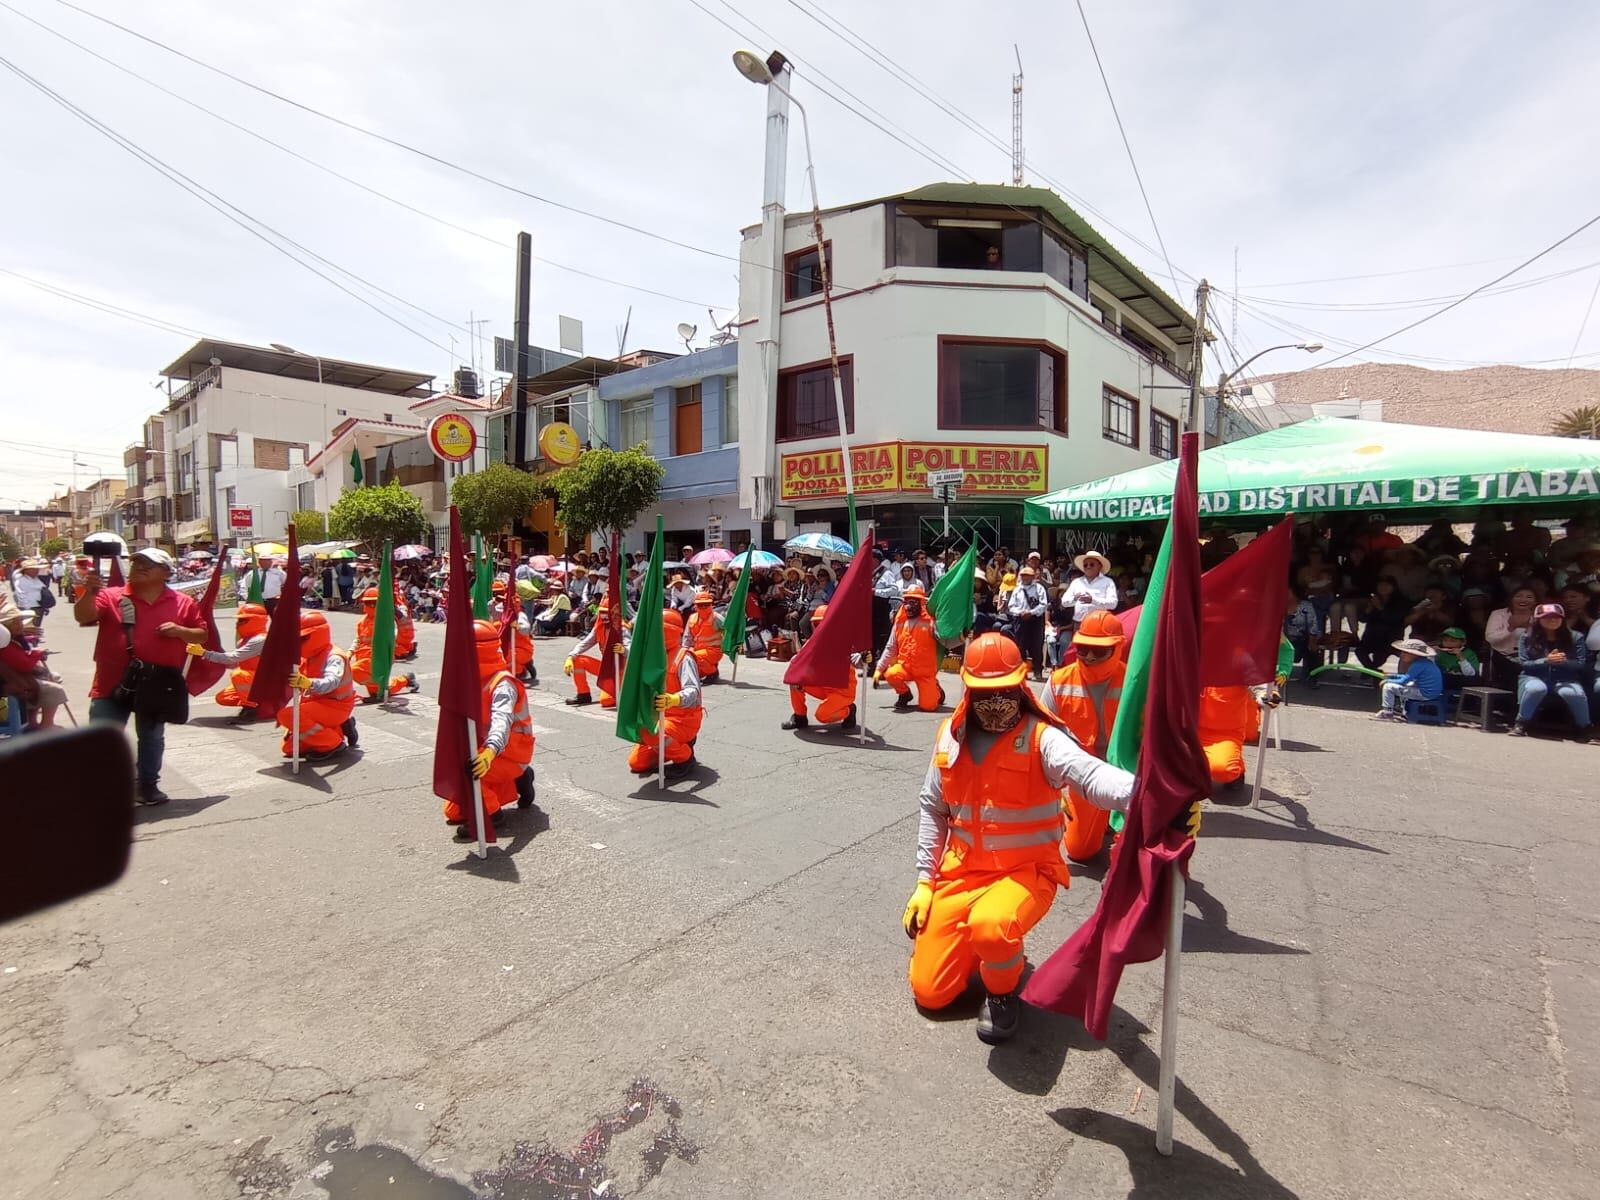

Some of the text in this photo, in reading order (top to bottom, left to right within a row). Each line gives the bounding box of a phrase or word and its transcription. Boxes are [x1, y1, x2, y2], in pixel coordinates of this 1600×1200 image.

[906, 448, 1040, 471] POLLERIA
[1050, 492, 1229, 520] MUNICIPALAD
[1239, 480, 1400, 511] DISTRITAL
[1412, 476, 1461, 502] DE
